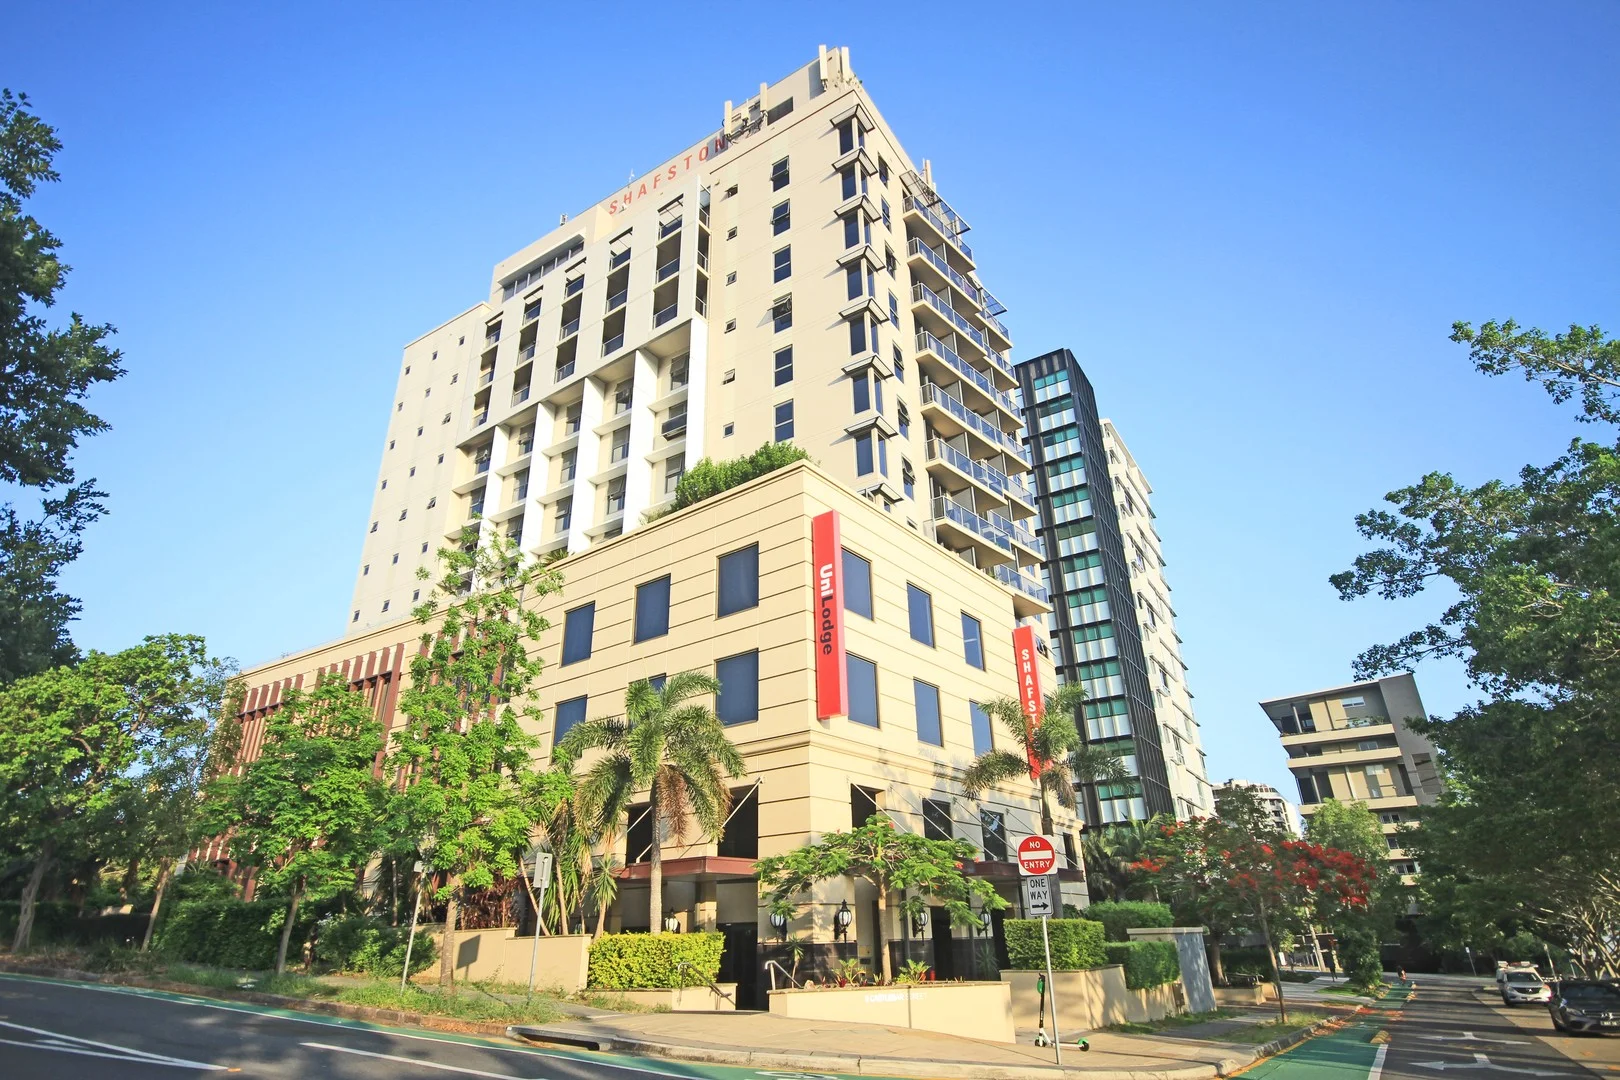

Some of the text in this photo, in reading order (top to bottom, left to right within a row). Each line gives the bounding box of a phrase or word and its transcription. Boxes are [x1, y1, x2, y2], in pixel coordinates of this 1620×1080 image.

[609, 136, 725, 215] SHAFSTON
[820, 564, 834, 655] UniLodge
[1022, 649, 1038, 735] SHAFST
[1024, 860, 1050, 868] ENTRY
[1030, 878, 1046, 888] ONE
[1030, 890, 1048, 900] WAY
